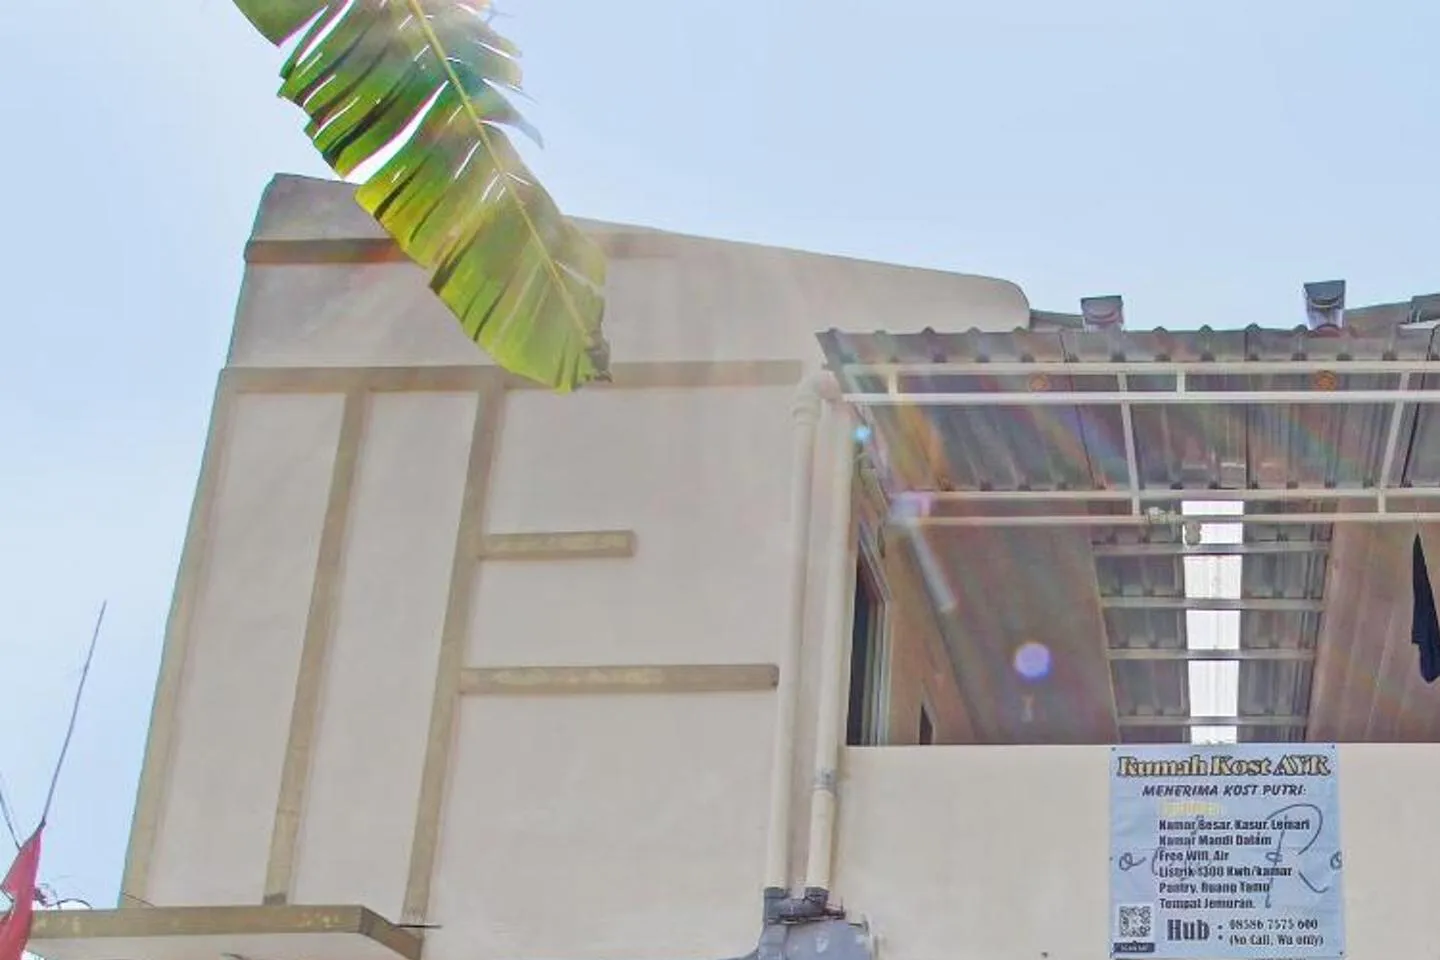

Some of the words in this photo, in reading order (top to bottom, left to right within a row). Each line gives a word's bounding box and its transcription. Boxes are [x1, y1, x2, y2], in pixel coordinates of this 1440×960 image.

[1117, 755, 1208, 777] Rumah
[1210, 756, 1272, 776] Kost
[1142, 785, 1218, 796] MENERIMA
[1224, 785, 1257, 796] KOST
[1159, 819, 1197, 830] Kamar
[1271, 819, 1310, 830] Lemari
[1159, 835, 1197, 845] Kamar
[1199, 834, 1233, 845] Mandi
[1236, 834, 1272, 845] Dalam
[1159, 850, 1183, 861] Free
[1213, 850, 1229, 861] Air
[1159, 866, 1193, 877] Listrik
[1201, 882, 1237, 894] Ruang
[1240, 882, 1270, 892] Tamu
[1160, 898, 1200, 909] Tempat
[1167, 919, 1210, 941] Hub
[1277, 934, 1293, 945] Wa
